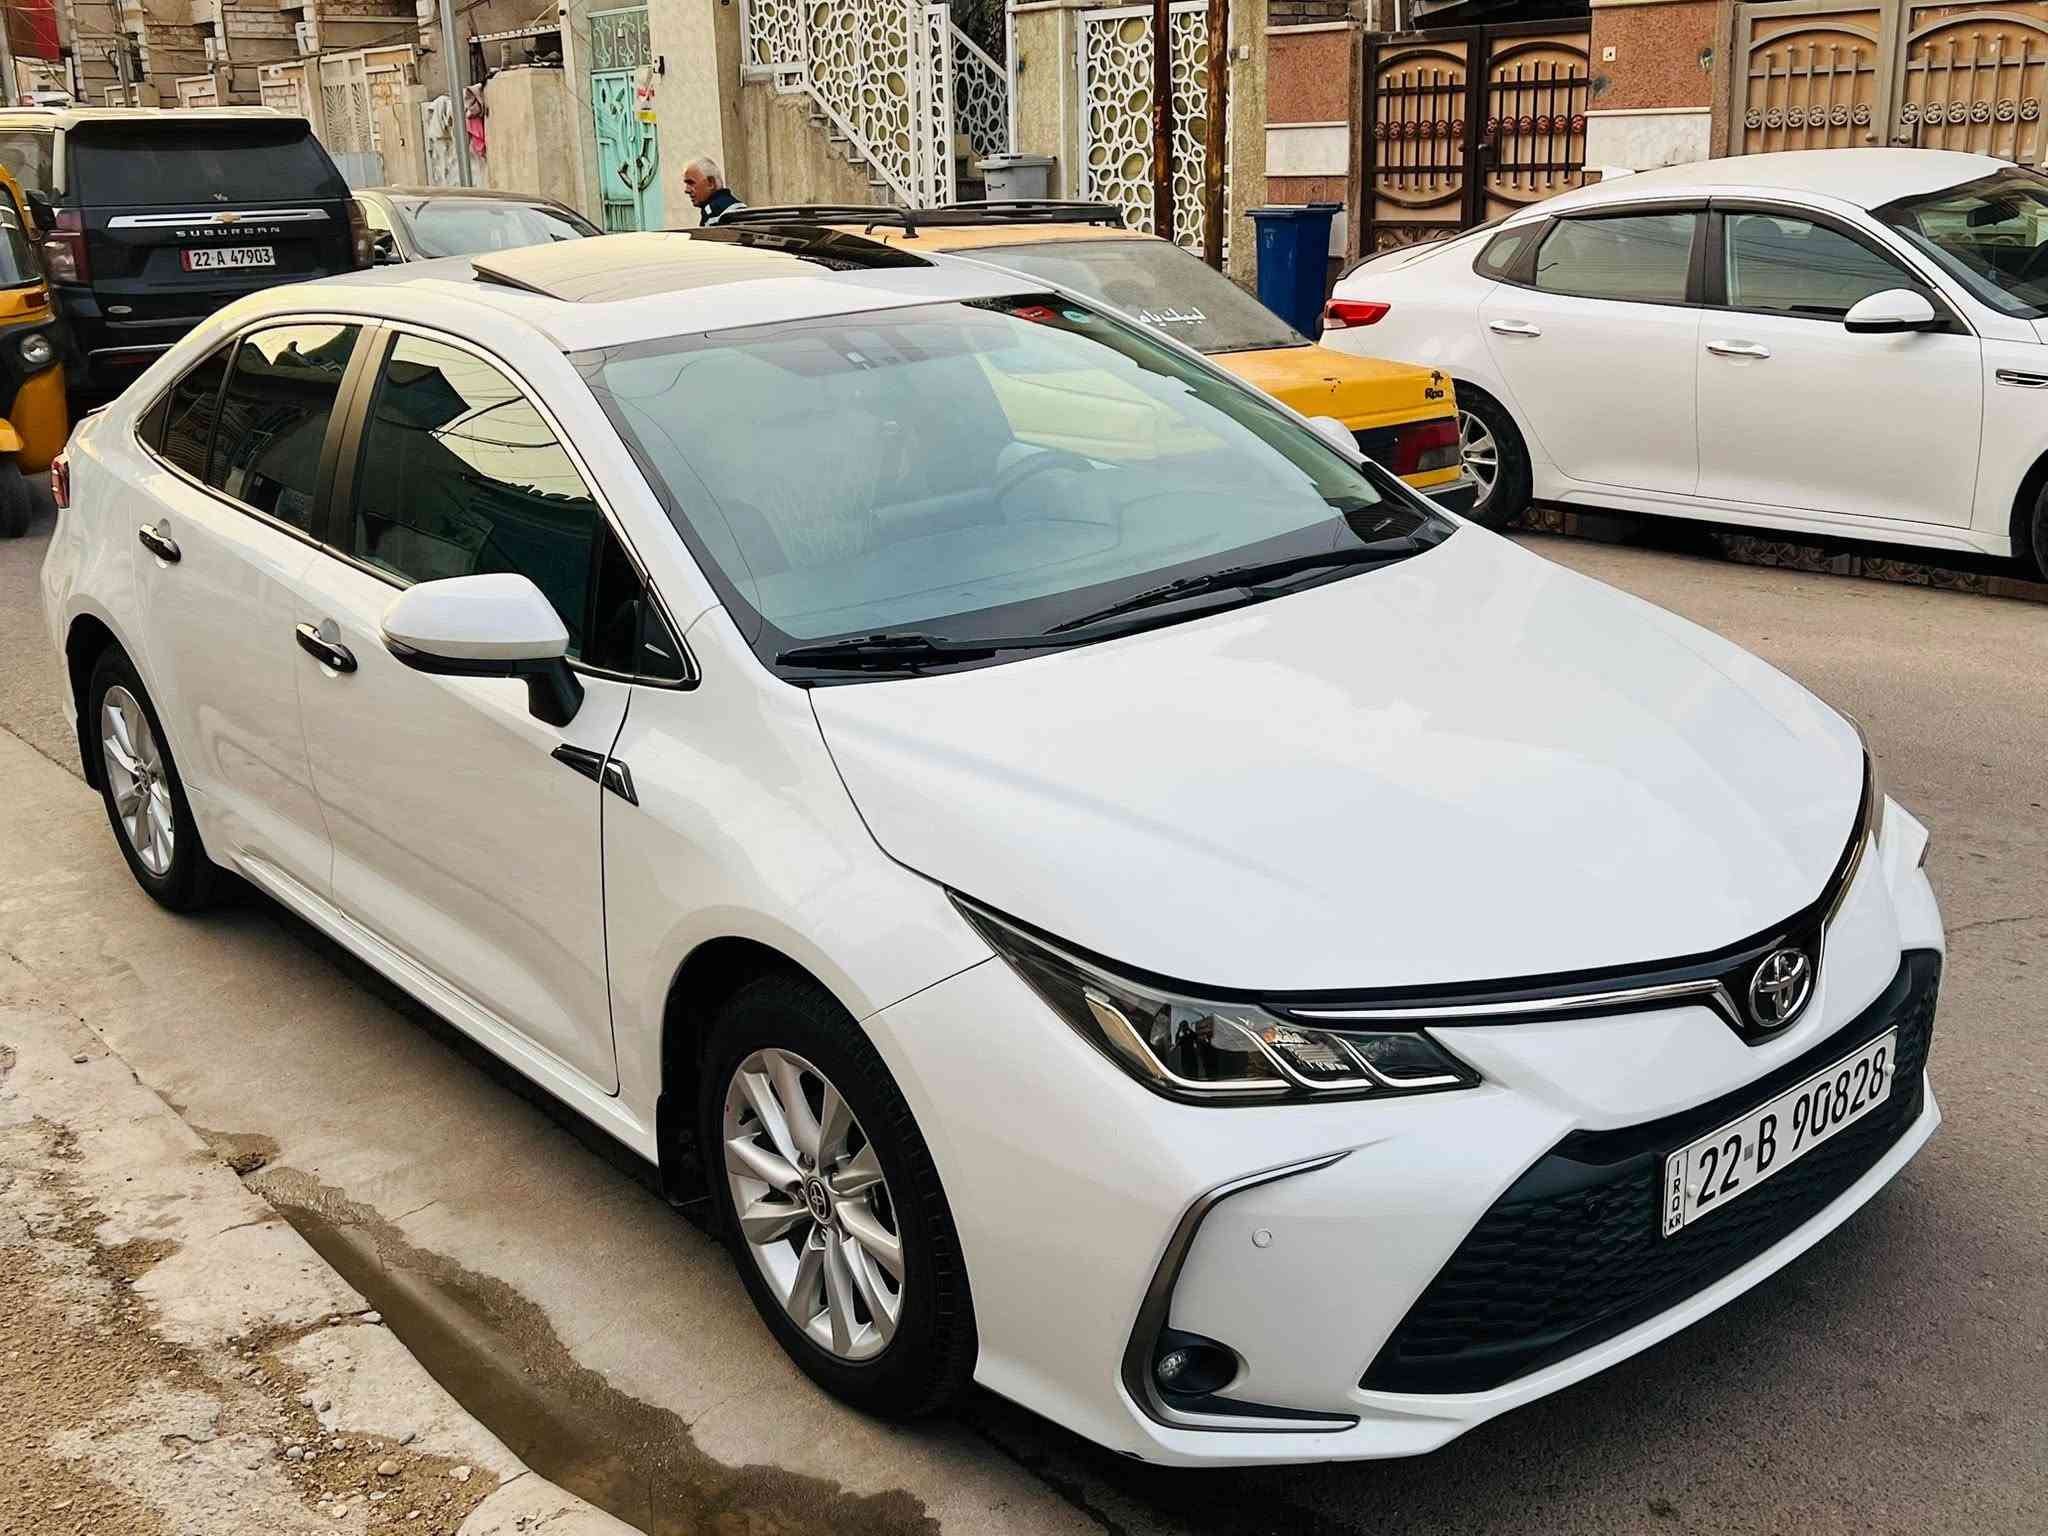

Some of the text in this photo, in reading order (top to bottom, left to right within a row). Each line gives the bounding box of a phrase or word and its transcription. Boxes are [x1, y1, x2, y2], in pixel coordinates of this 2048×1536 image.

[175, 226, 280, 238] SUBURBAN
[231, 248, 271, 265] 47903
[1696, 1046, 1887, 1208] 22 B 90828
